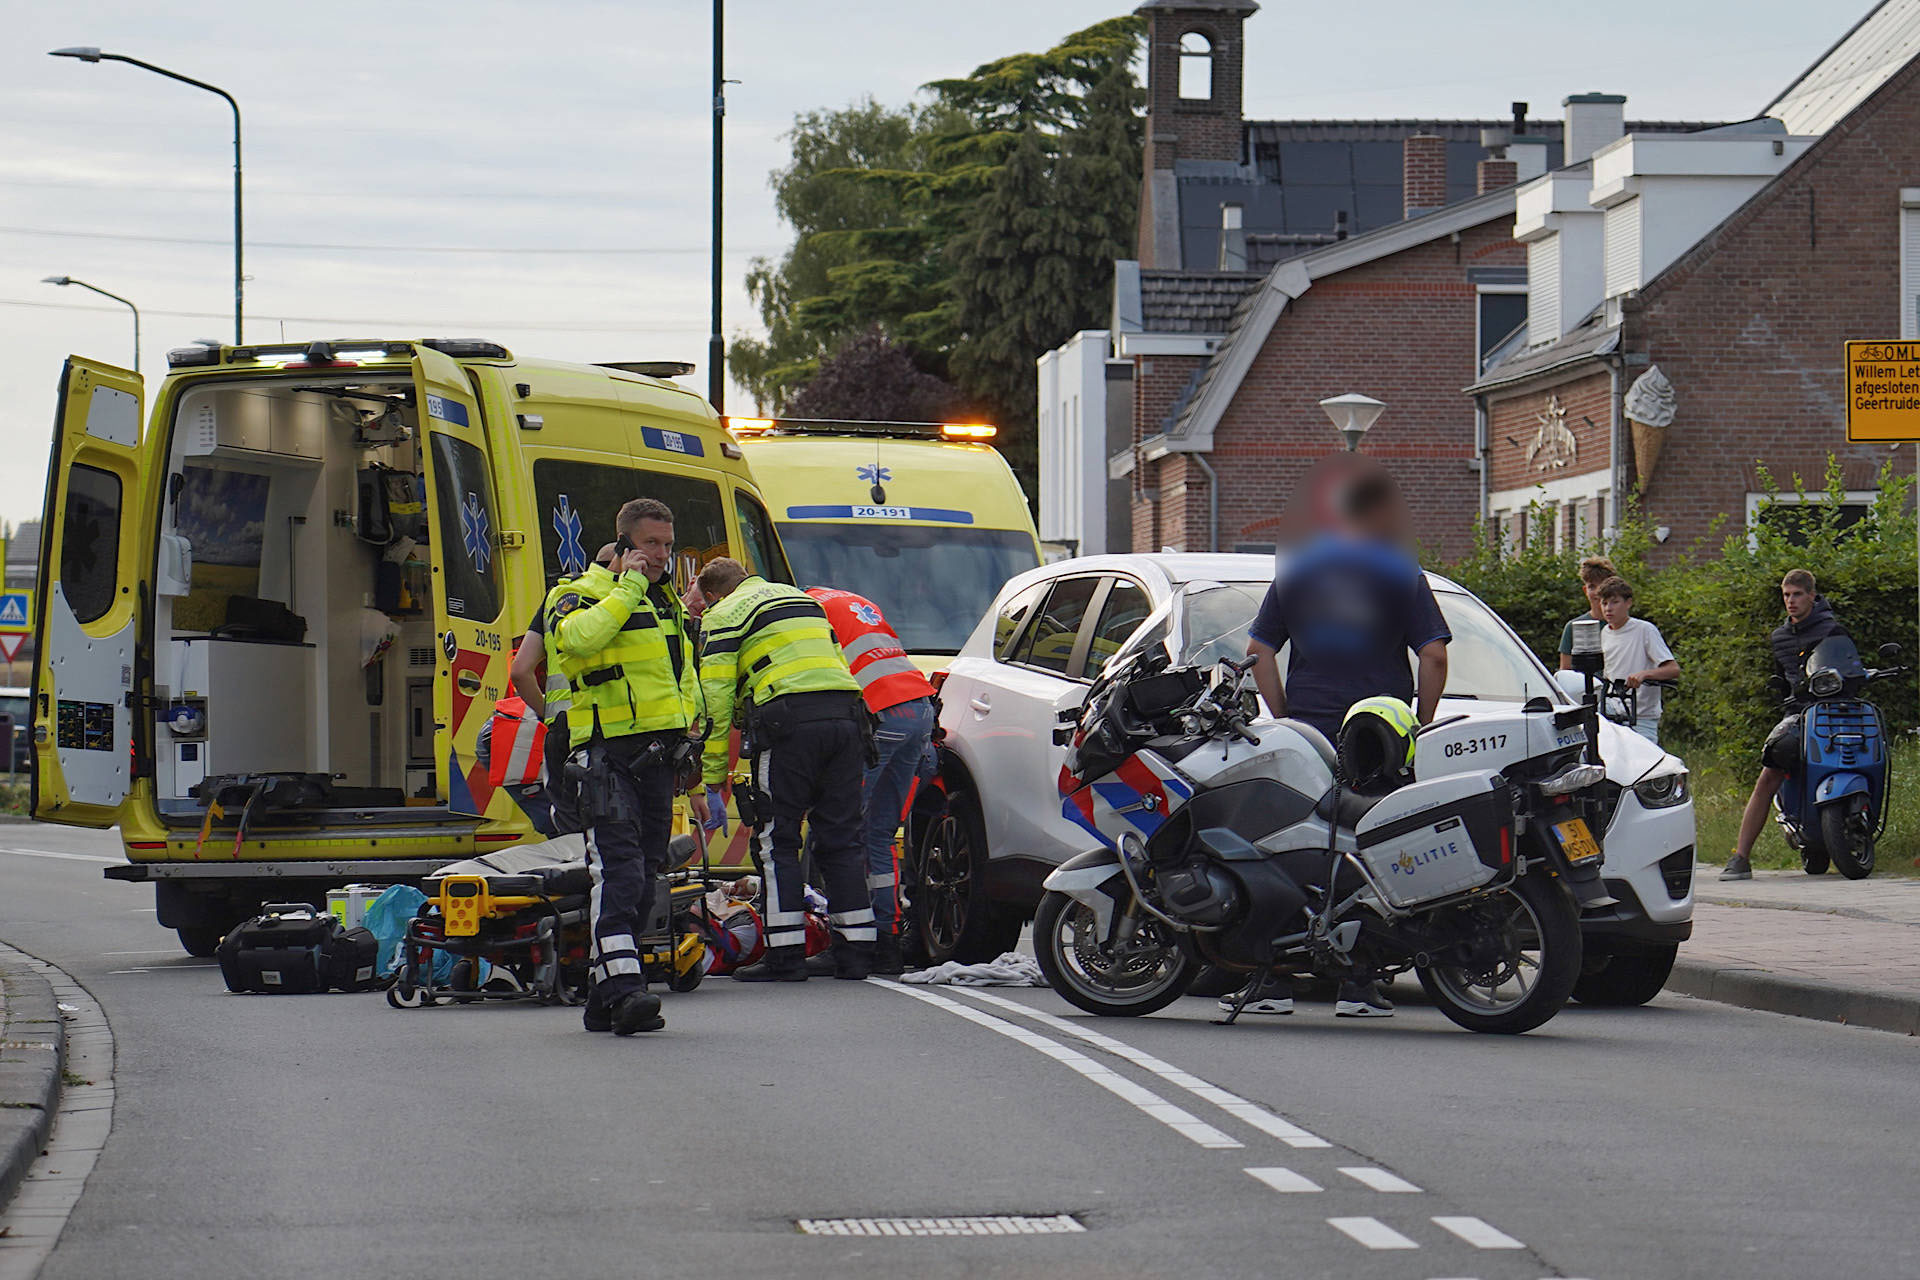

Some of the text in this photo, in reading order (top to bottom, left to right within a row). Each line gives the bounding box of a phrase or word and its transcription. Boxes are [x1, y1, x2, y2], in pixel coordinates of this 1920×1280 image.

[1884, 345, 1920, 360] OML
[1855, 364, 1920, 378] Willem Let
[1855, 381, 1919, 398] afgesloten
[1855, 396, 1920, 410] Geertruide
[857, 507, 906, 517] 20-191
[475, 628, 501, 651] 20-195
[1444, 734, 1508, 758] 08-3117
[1391, 842, 1459, 875] POLITIE
